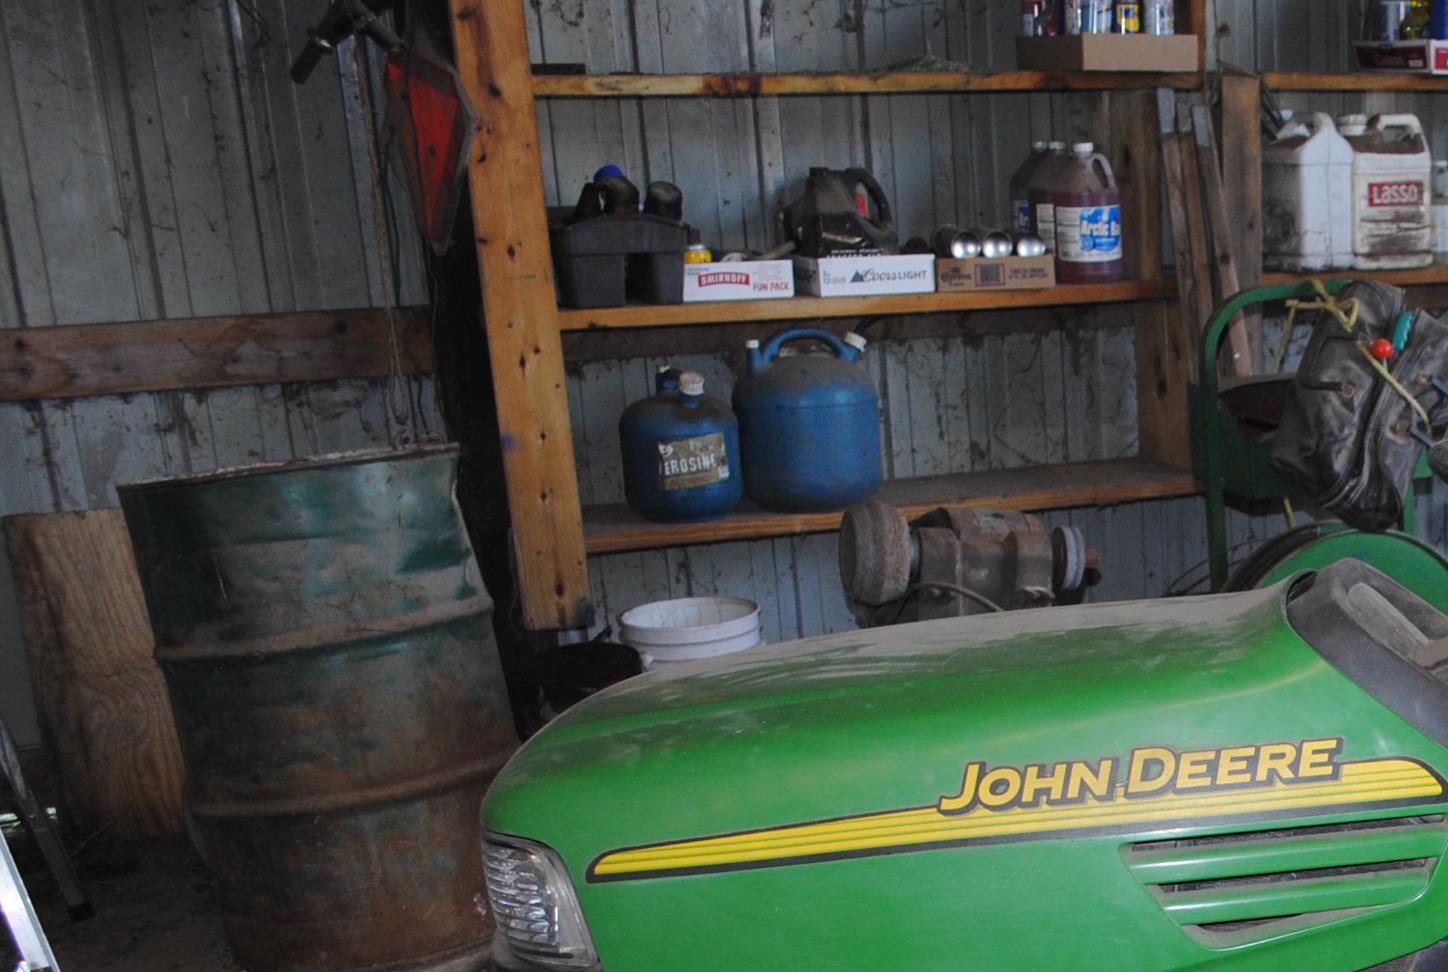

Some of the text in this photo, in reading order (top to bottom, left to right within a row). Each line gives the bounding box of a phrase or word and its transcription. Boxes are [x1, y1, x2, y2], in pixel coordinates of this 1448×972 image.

[700, 272, 747, 286] SMIRNOFF
[898, 270, 927, 280] LIGHT
[938, 737, 1340, 813] JOHN DEERE
